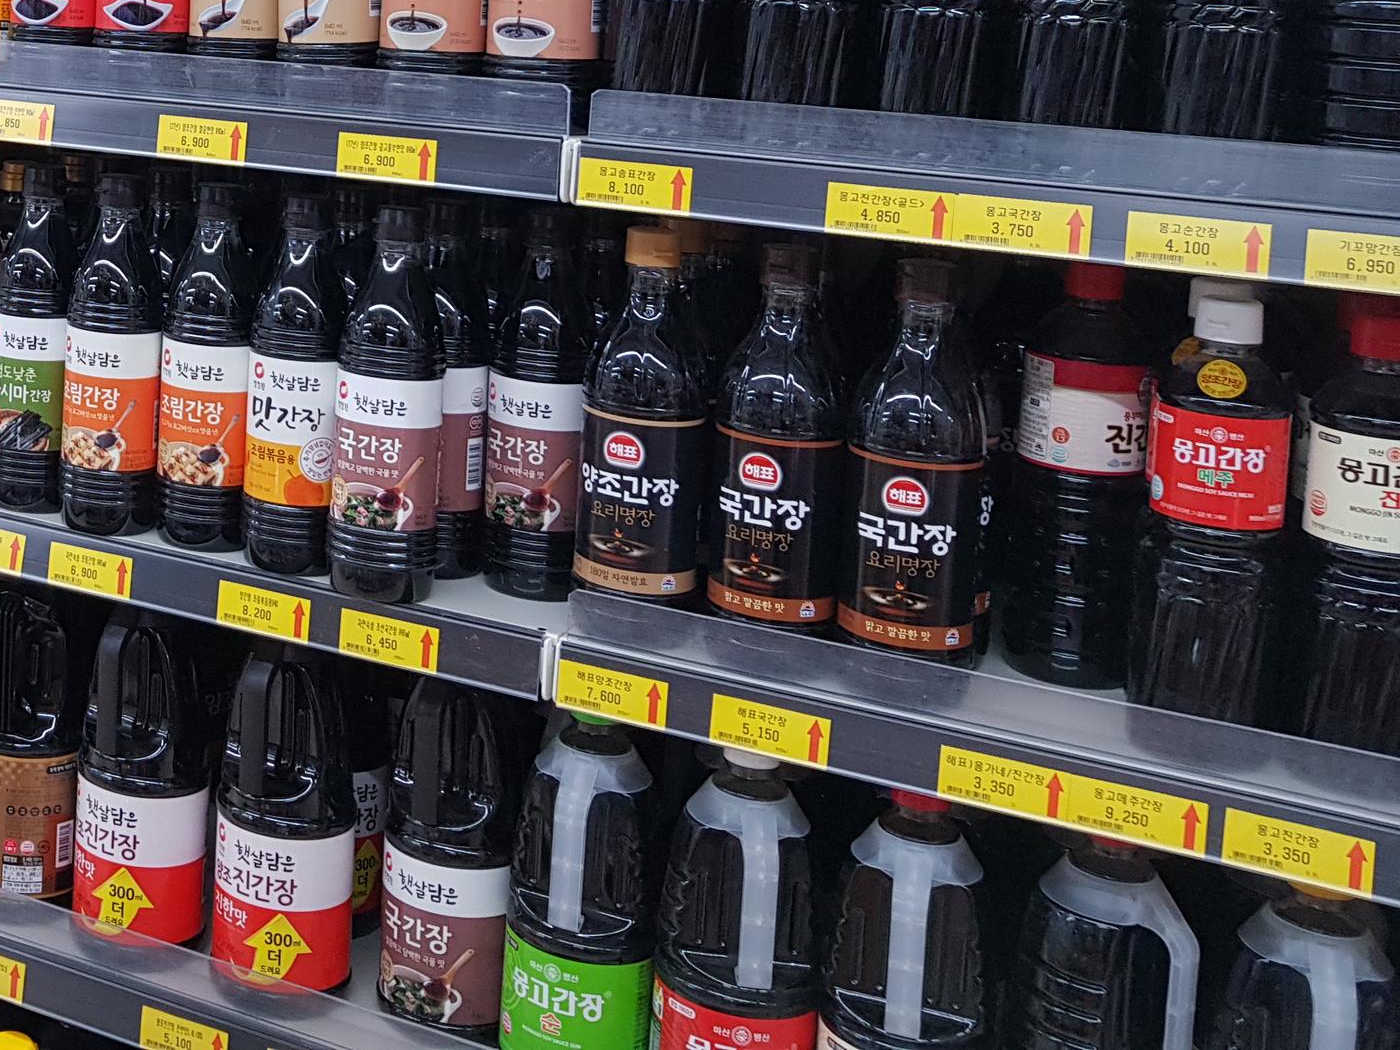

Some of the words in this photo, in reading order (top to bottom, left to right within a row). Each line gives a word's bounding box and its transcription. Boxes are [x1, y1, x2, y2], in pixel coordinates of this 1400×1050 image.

[180, 135, 210, 148] 6,900
[363, 154, 396, 168] 6,900
[600, 166, 656, 182] 몽고송표간장
[608, 181, 645, 196] 8,100
[860, 208, 901, 225] 4,850
[985, 205, 1042, 222] 몽고국간장
[991, 222, 1034, 238] 3,750
[1165, 239, 1210, 256] 4,100
[1346, 257, 1395, 274] 6,950
[75, 345, 121, 368] 햇살담은
[175, 359, 225, 382] 햇살담은
[161, 394, 224, 425] 조림간장
[353, 392, 408, 417] 햇살담은
[338, 428, 403, 463] 국간장
[609, 441, 639, 458] 해표
[1172, 437, 1266, 474] 몽고간장
[744, 463, 775, 481] 해표
[1197, 468, 1235, 487] 메주
[582, 461, 679, 507] 양조간장
[719, 485, 810, 531] 국간장
[889, 488, 922, 506] 해표
[725, 524, 795, 551] 요리명장
[858, 511, 957, 557] 국간장
[865, 550, 941, 579] 요리명장
[365, 634, 398, 651] 6,450
[576, 670, 633, 692] 해표양조간장
[586, 686, 621, 706] 7,600
[737, 706, 788, 728] 해표국간장
[742, 722, 780, 743] 5,150
[1094, 786, 1164, 814] 몽고메주간장
[1104, 806, 1149, 828] 9,250
[1263, 841, 1311, 865] 3,350
[111, 900, 125, 919] 더
[385, 900, 453, 955] 국간장
[513, 964, 604, 1023] 몽고간장
[539, 1013, 561, 1036] 순
